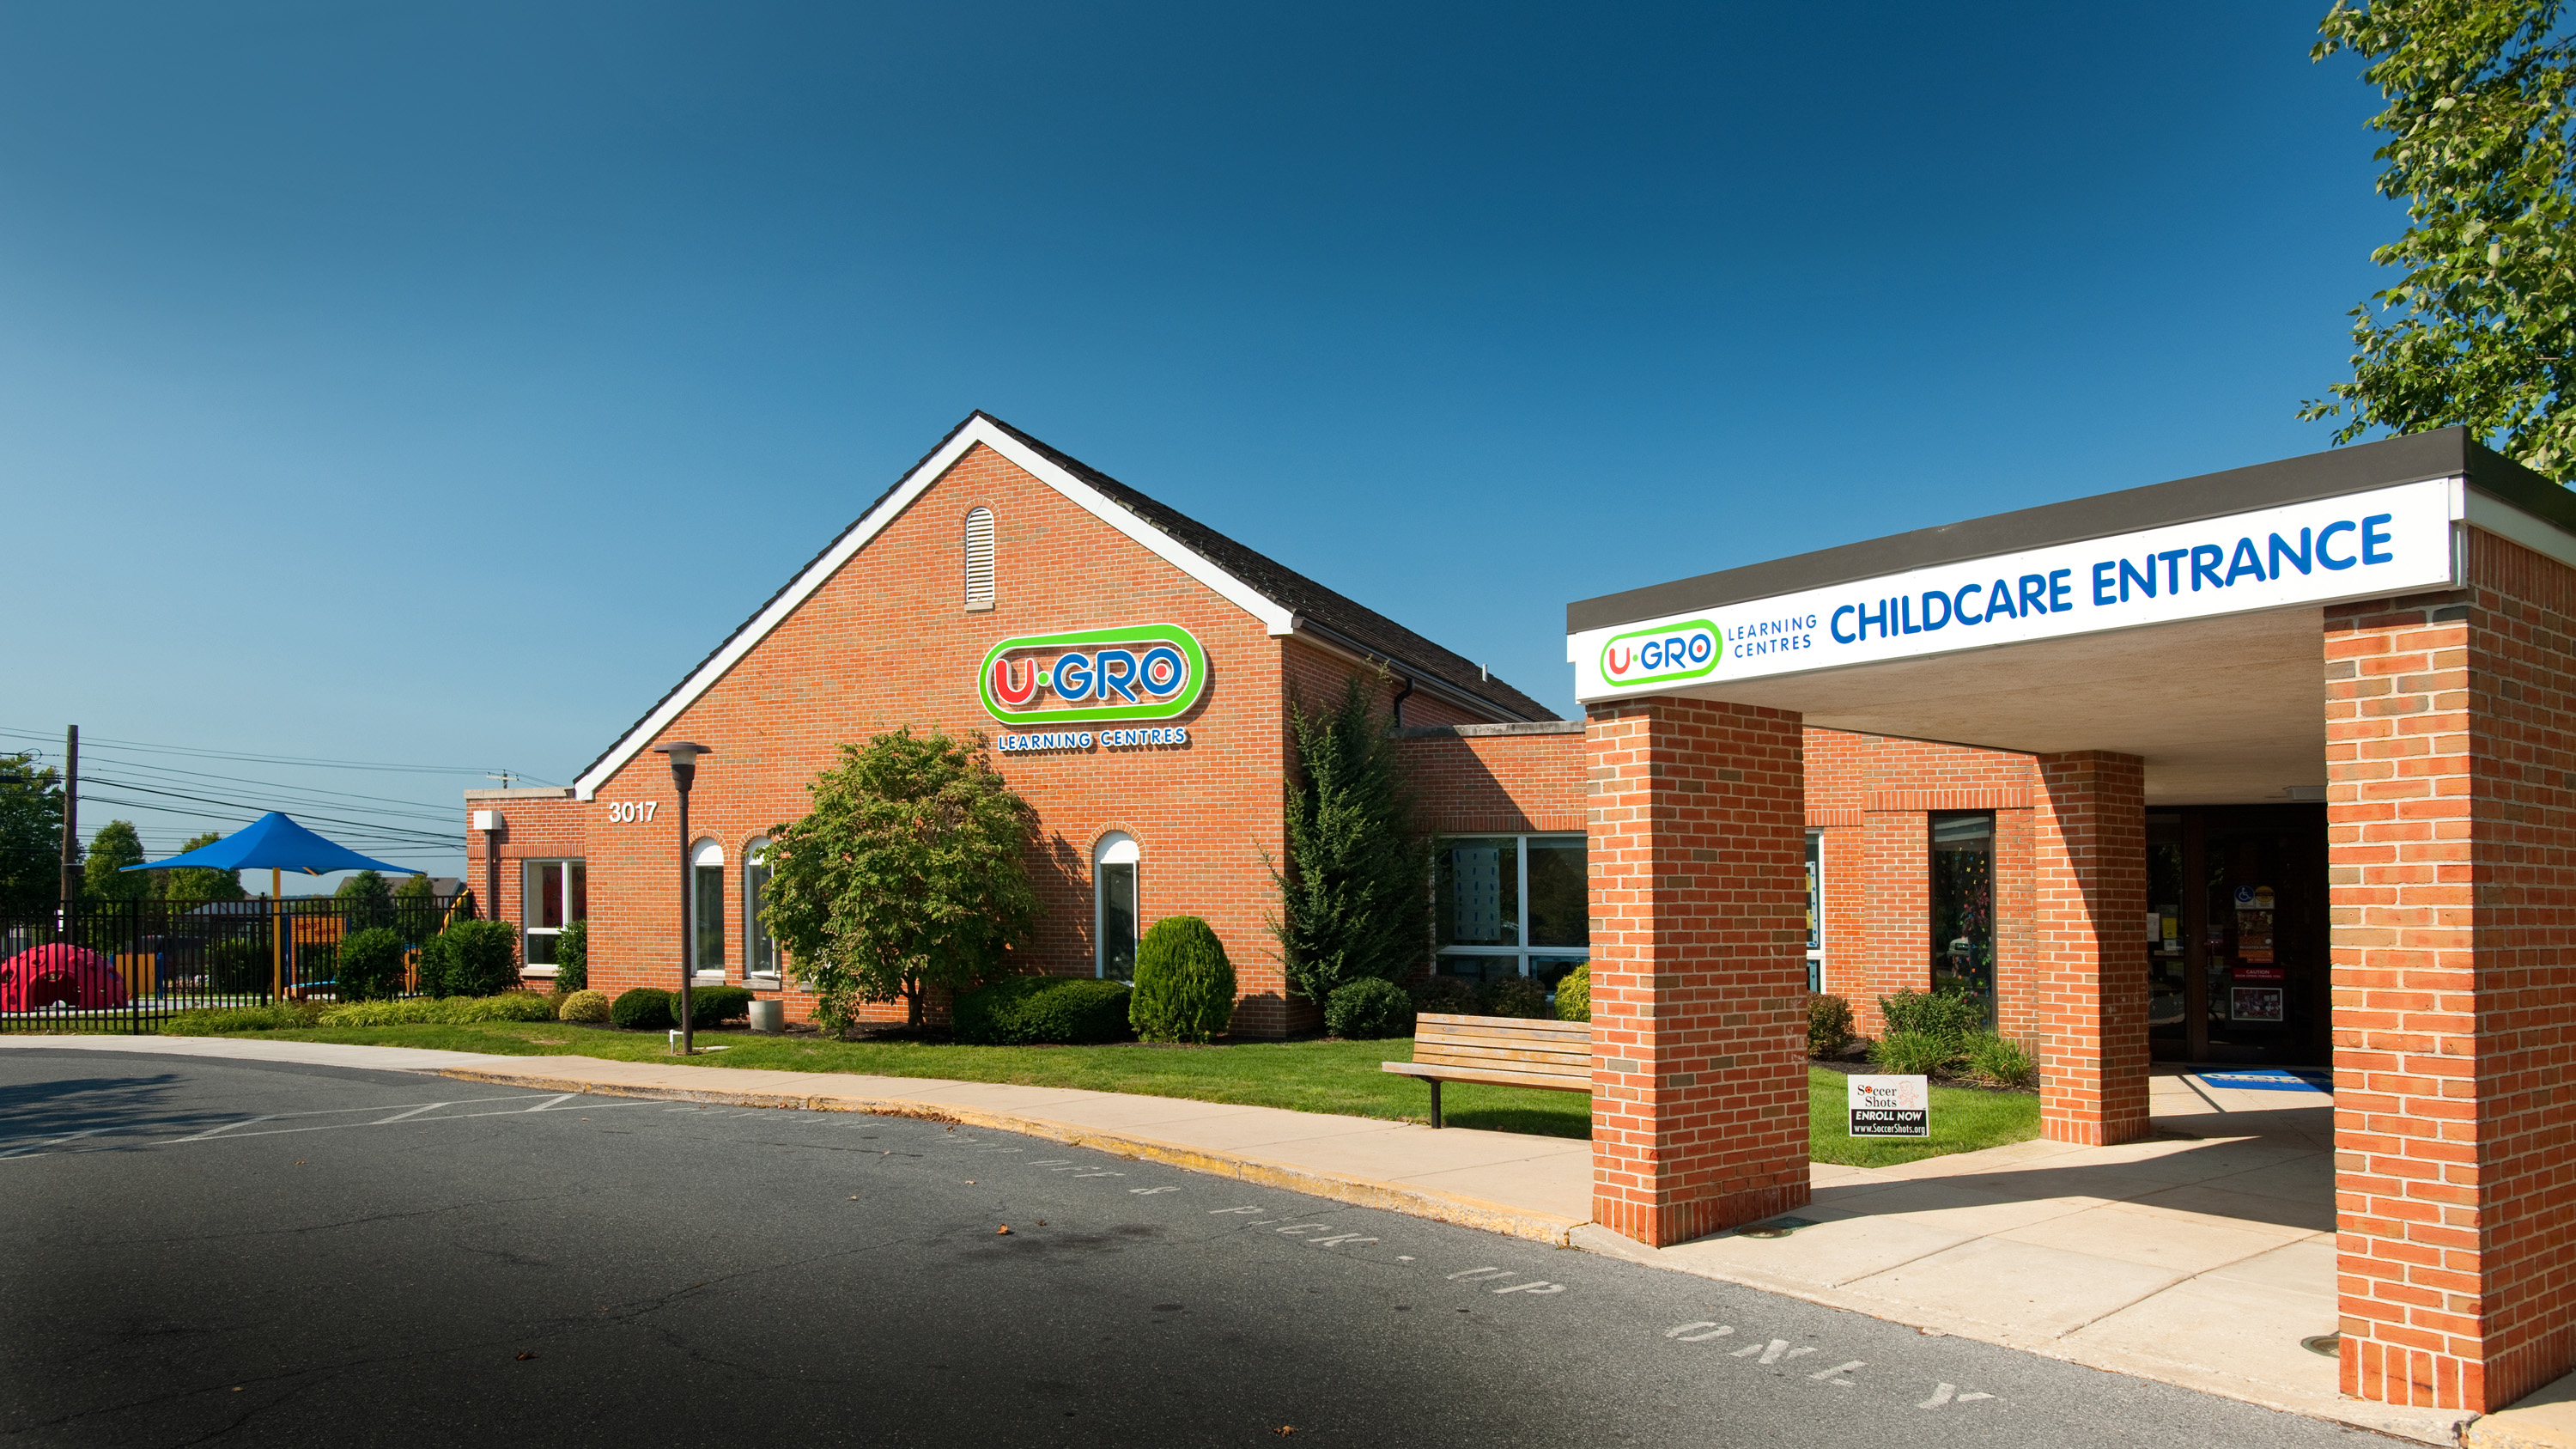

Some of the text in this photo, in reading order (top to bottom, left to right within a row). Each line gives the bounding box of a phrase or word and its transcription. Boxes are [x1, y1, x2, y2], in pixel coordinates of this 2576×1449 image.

[1830, 513, 2394, 644] CHILDCARE ENTRANCE
[1728, 613, 1818, 642] LEARNING
[1735, 634, 1812, 658] CENTRES
[997, 728, 1187, 752] LEARNING CENTRES
[609, 801, 658, 822] 3017
[1865, 1096, 1897, 1107] Shots
[1856, 1111, 1923, 1121] ENROLL NOW
[1854, 1123, 1925, 1135] www.SoccerShots.org
[1128, 1186, 1182, 1196] &
[1666, 1321, 1997, 1409] ONLY
